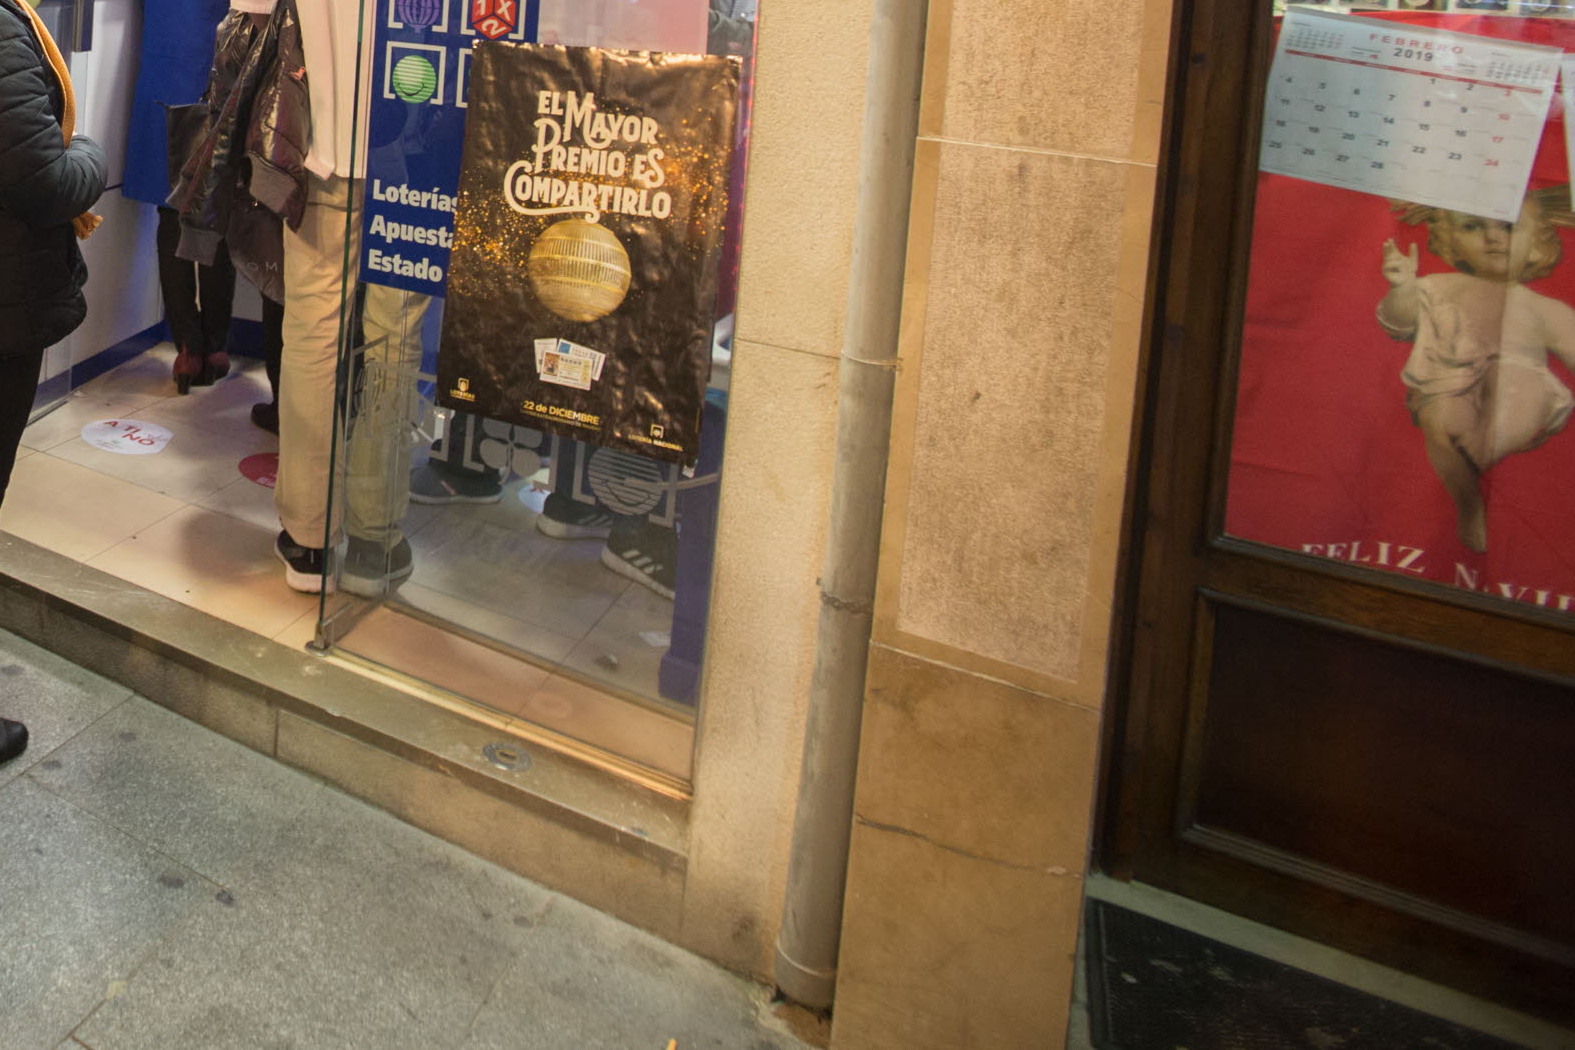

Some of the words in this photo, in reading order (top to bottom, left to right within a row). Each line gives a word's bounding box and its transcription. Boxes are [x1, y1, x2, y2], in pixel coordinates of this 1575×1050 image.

[1369, 33, 1465, 54] FEBRERO
[1393, 47, 1434, 62] 2019
[1466, 83, 1474, 91] 2
[537, 90, 564, 116] EL
[562, 90, 659, 150] MAYOR
[531, 118, 626, 177] PREMIO
[632, 147, 665, 188] ES
[503, 160, 673, 224] COMPARTIRLO
[368, 248, 443, 283] Estado
[524, 399, 535, 411] 22
[536, 403, 548, 413] de
[549, 406, 600, 426] DICIEMBRE
